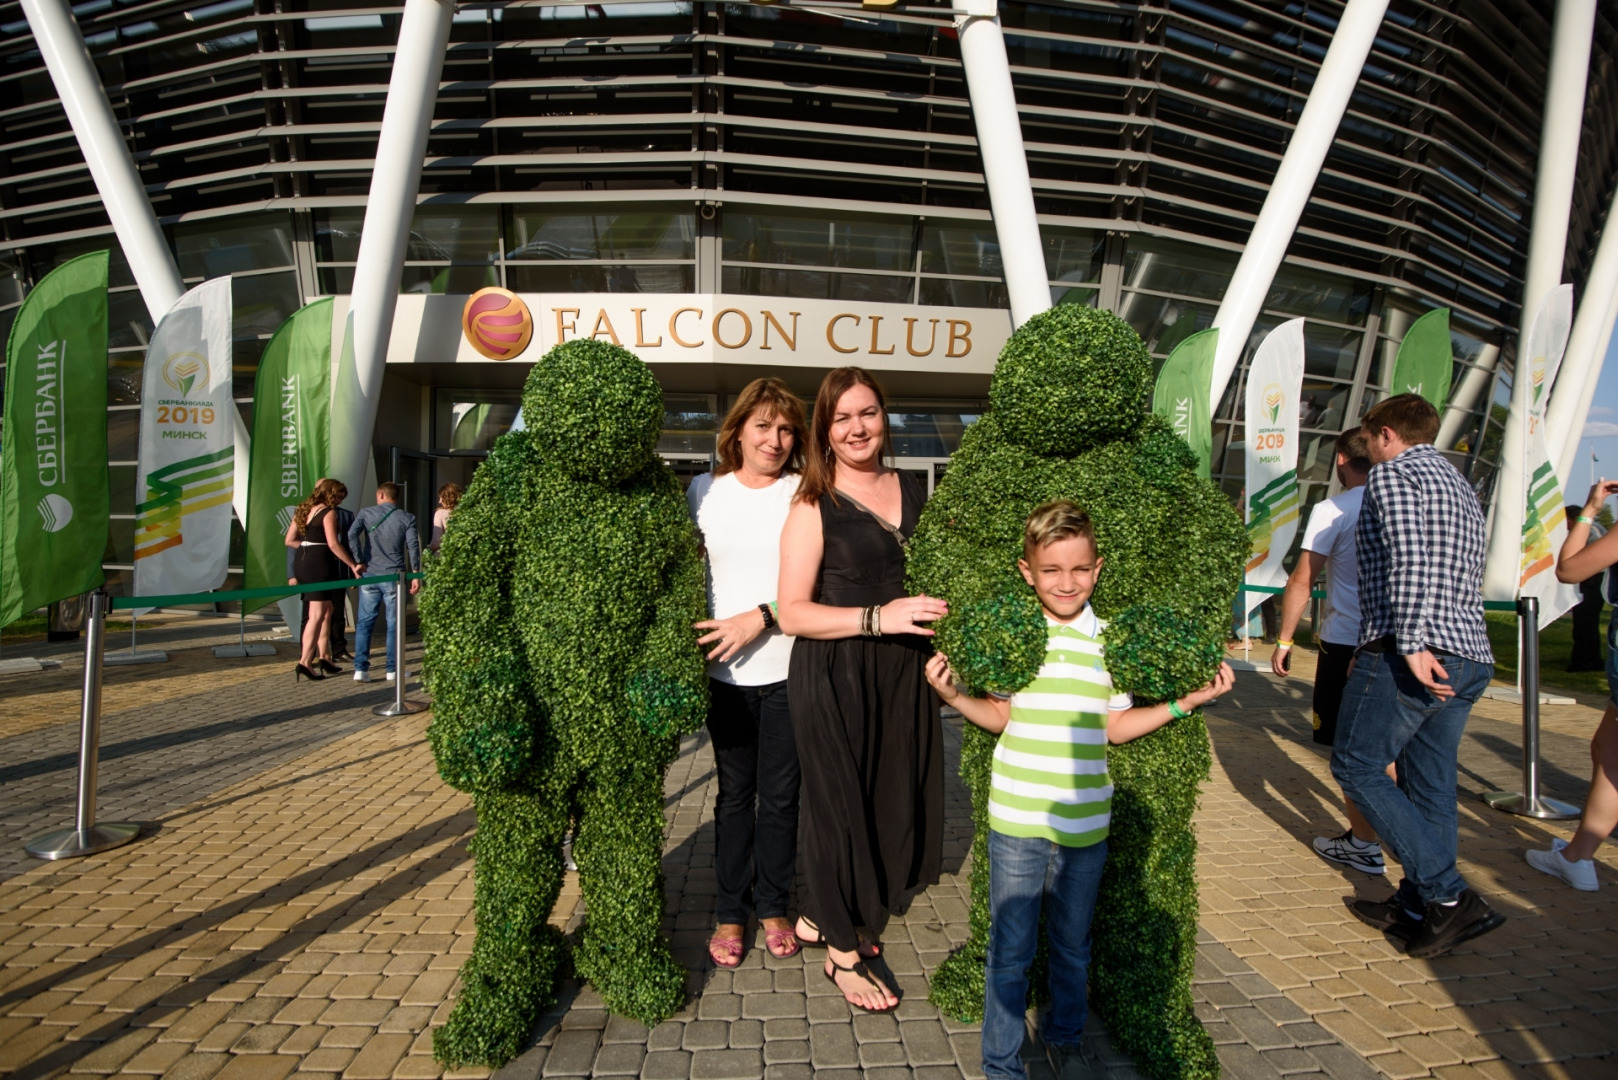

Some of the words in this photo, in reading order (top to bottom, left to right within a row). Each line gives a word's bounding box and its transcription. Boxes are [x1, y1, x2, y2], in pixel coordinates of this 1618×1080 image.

[551, 307, 801, 351] FALCON
[826, 313, 974, 359] CLUB
[35, 340, 60, 488] СБЕРБАНК
[157, 399, 214, 408] СБЕРБАНКИАДА
[157, 406, 215, 426] 2019
[162, 430, 207, 440] МИНСК
[281, 375, 299, 498] SBERBANK
